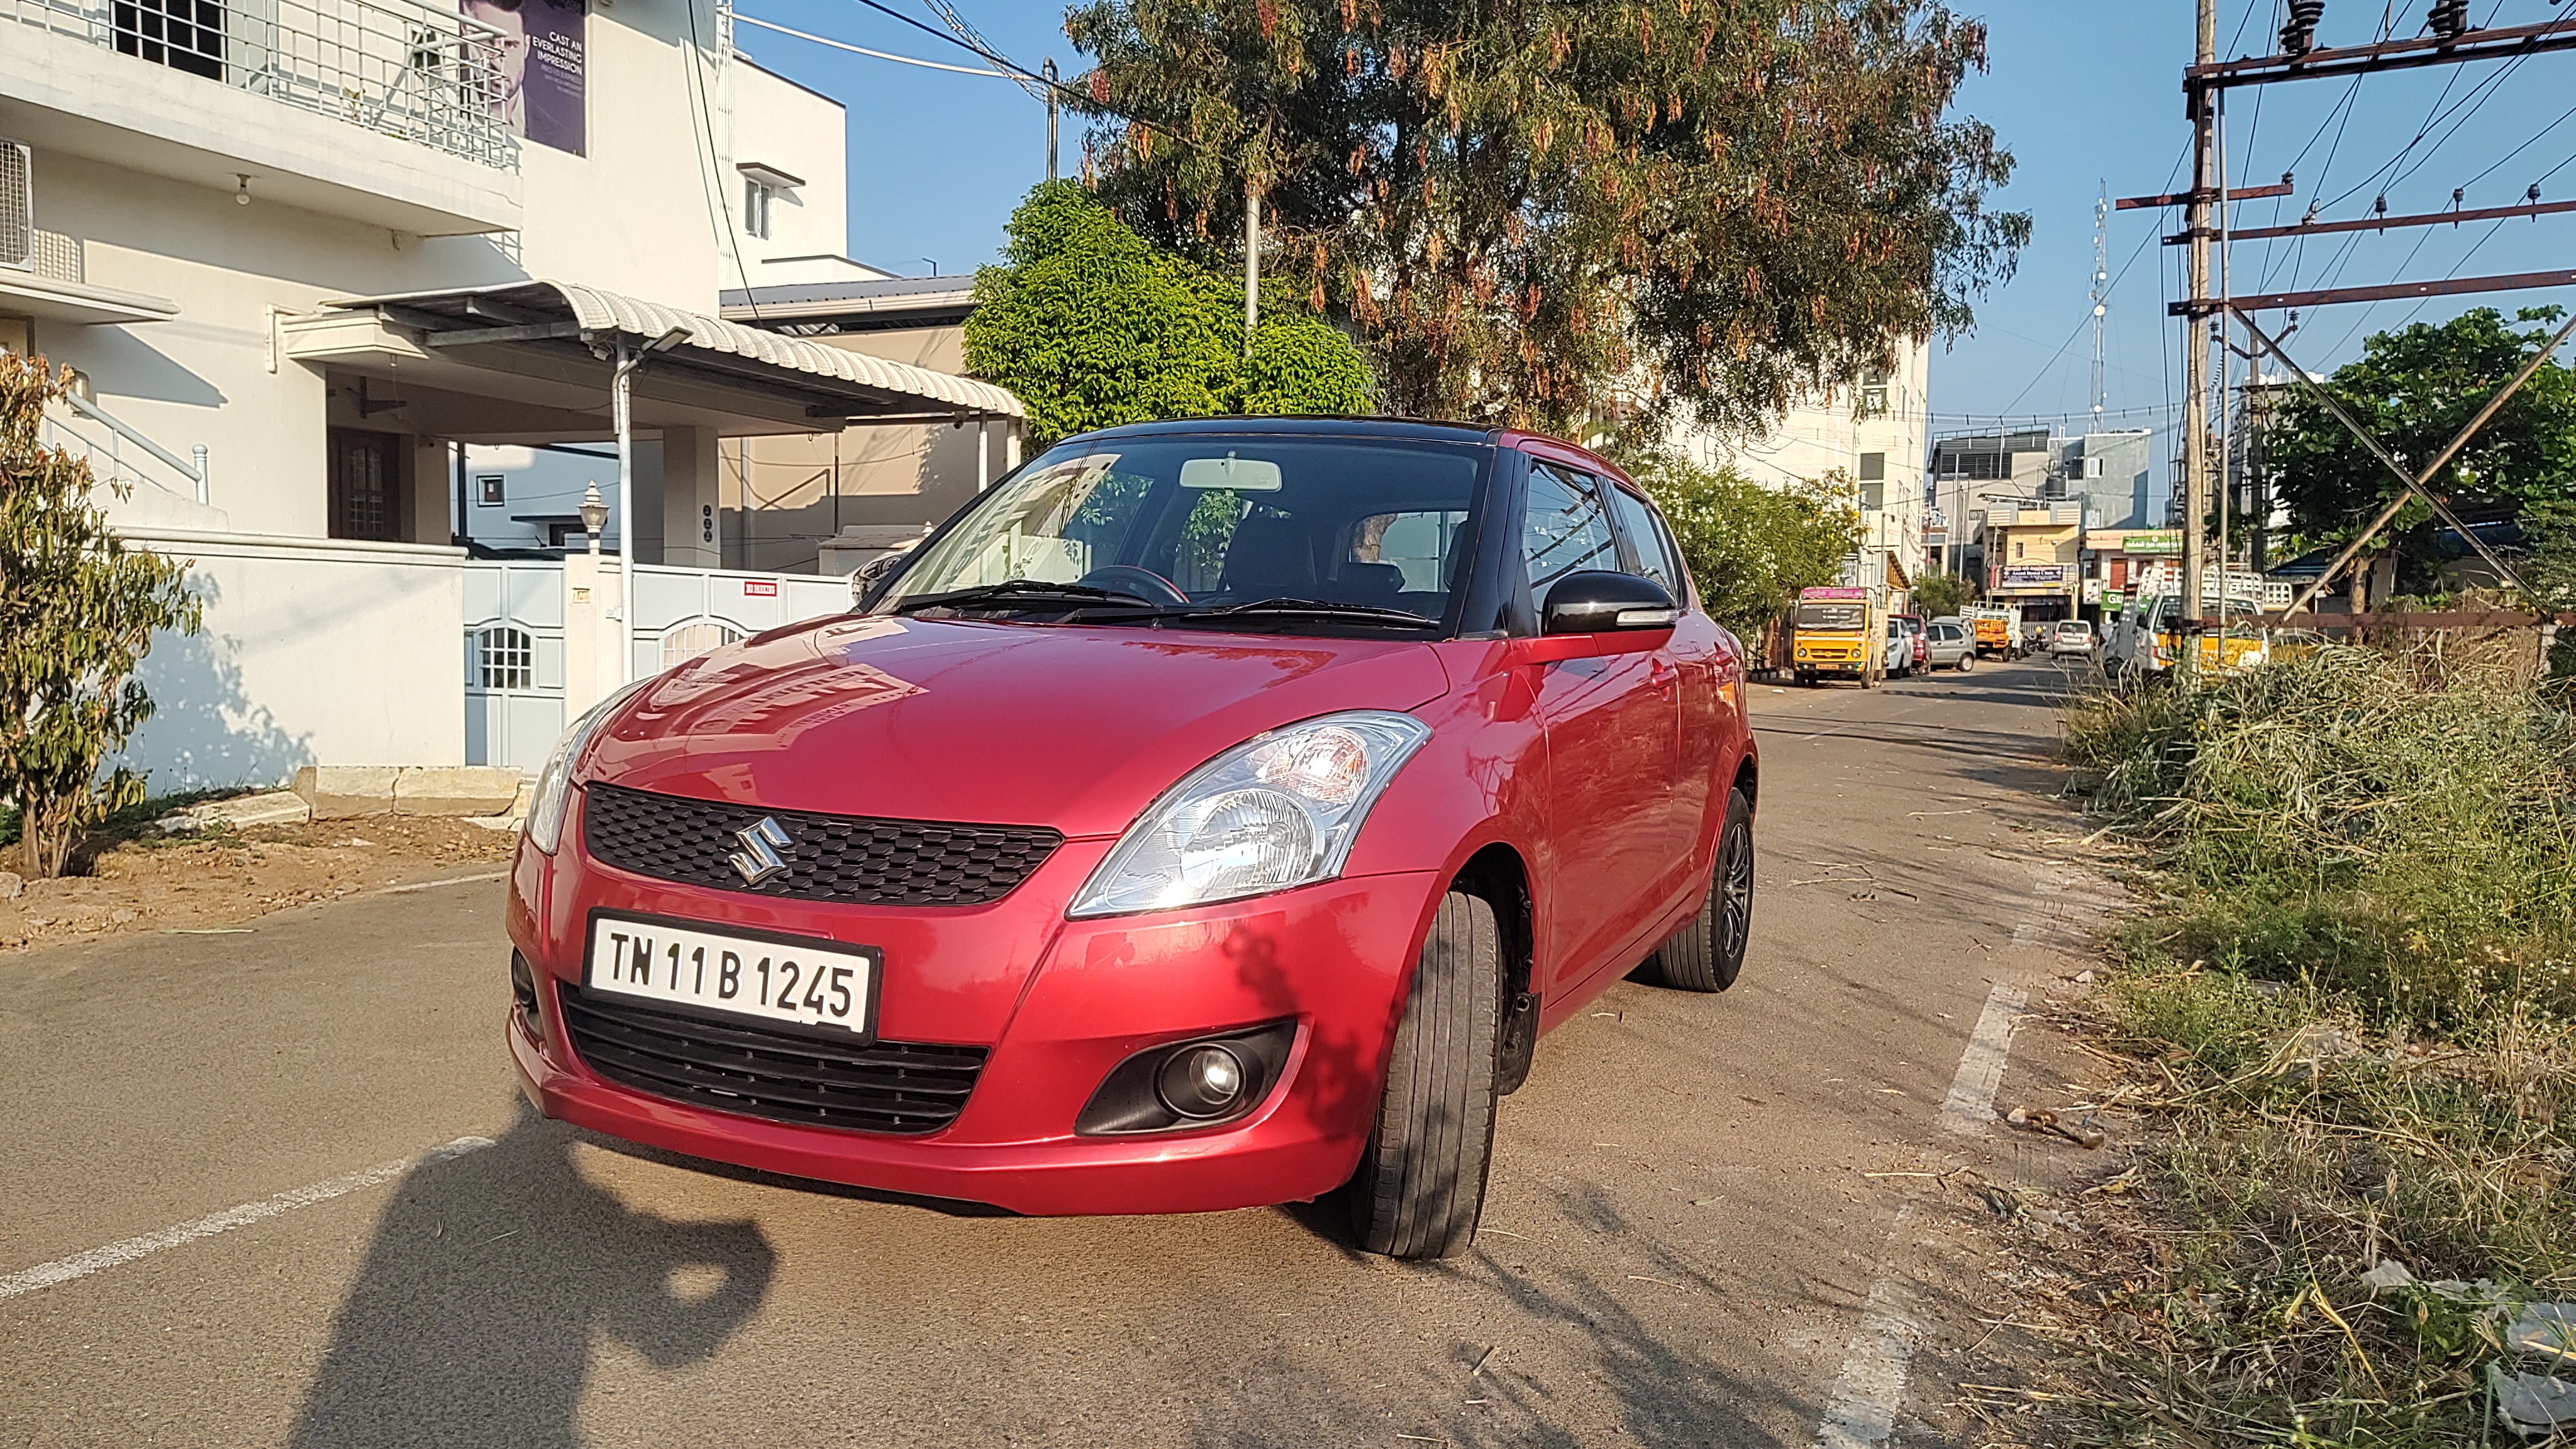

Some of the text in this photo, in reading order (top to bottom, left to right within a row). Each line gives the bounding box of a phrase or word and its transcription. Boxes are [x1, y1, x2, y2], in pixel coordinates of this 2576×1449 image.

[533, 36, 582, 64] EVERLASTING
[549, 31, 582, 52] CAST AN
[537, 50, 582, 75] IMPRESSION
[746, 584, 776, 595] NO PARKING
[611, 933, 854, 1018] TN 11 B 1245
